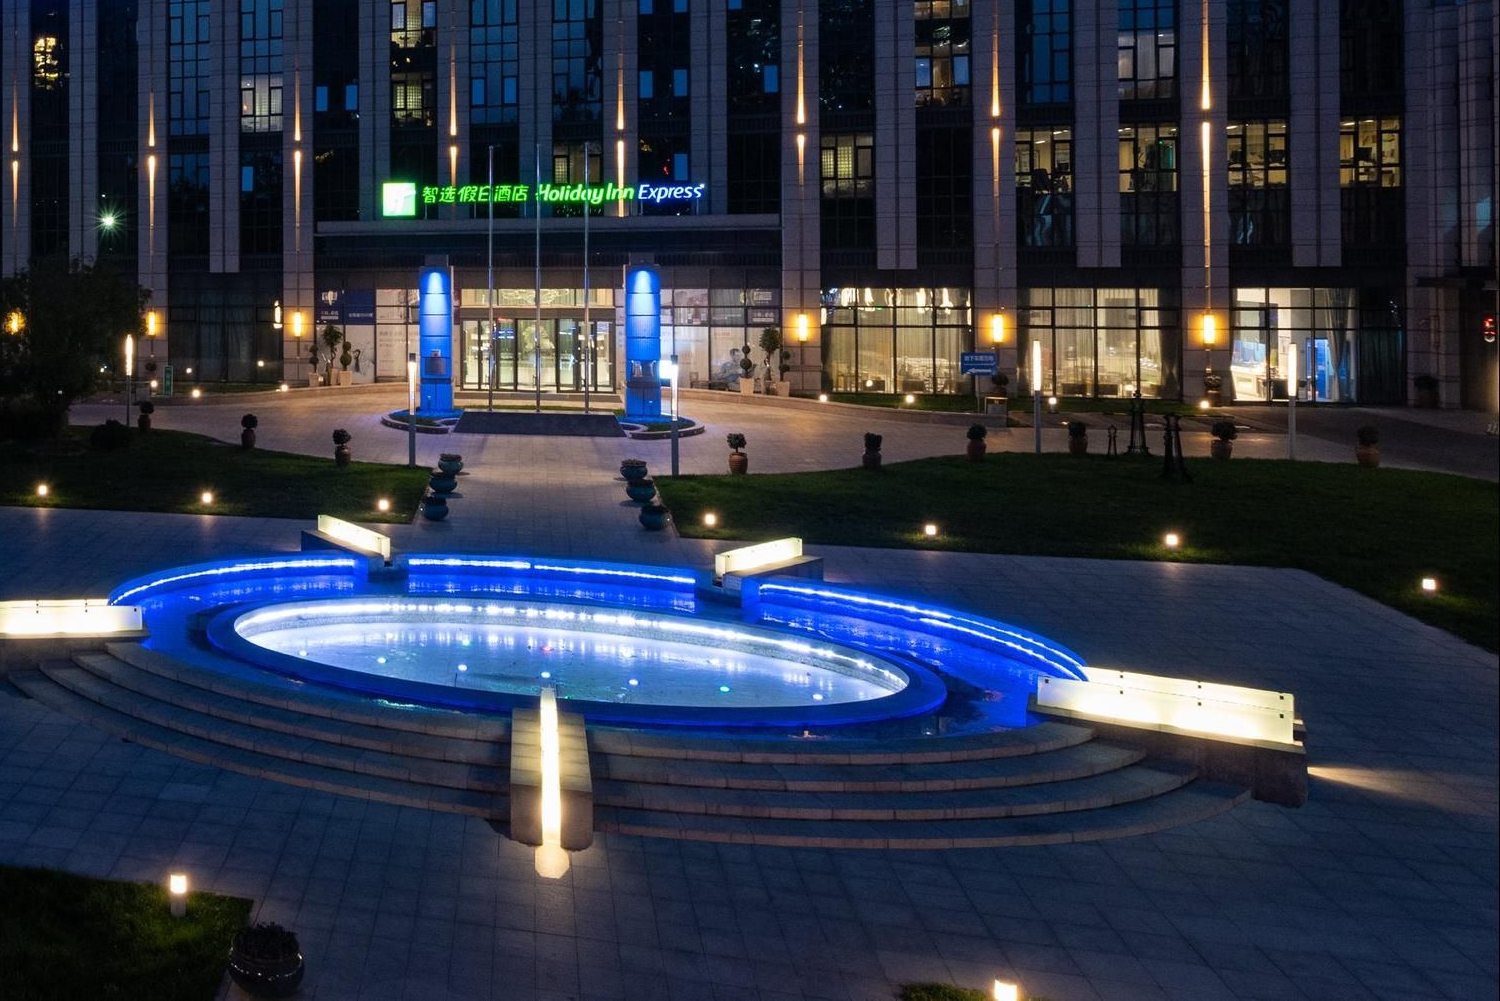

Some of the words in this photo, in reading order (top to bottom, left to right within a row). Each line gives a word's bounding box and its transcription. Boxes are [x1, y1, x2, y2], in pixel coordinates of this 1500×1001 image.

[422, 185, 529, 203] 智选假日酒店
[536, 183, 605, 204] Holiday
[605, 183, 634, 201] Inn
[638, 184, 705, 203] Express
